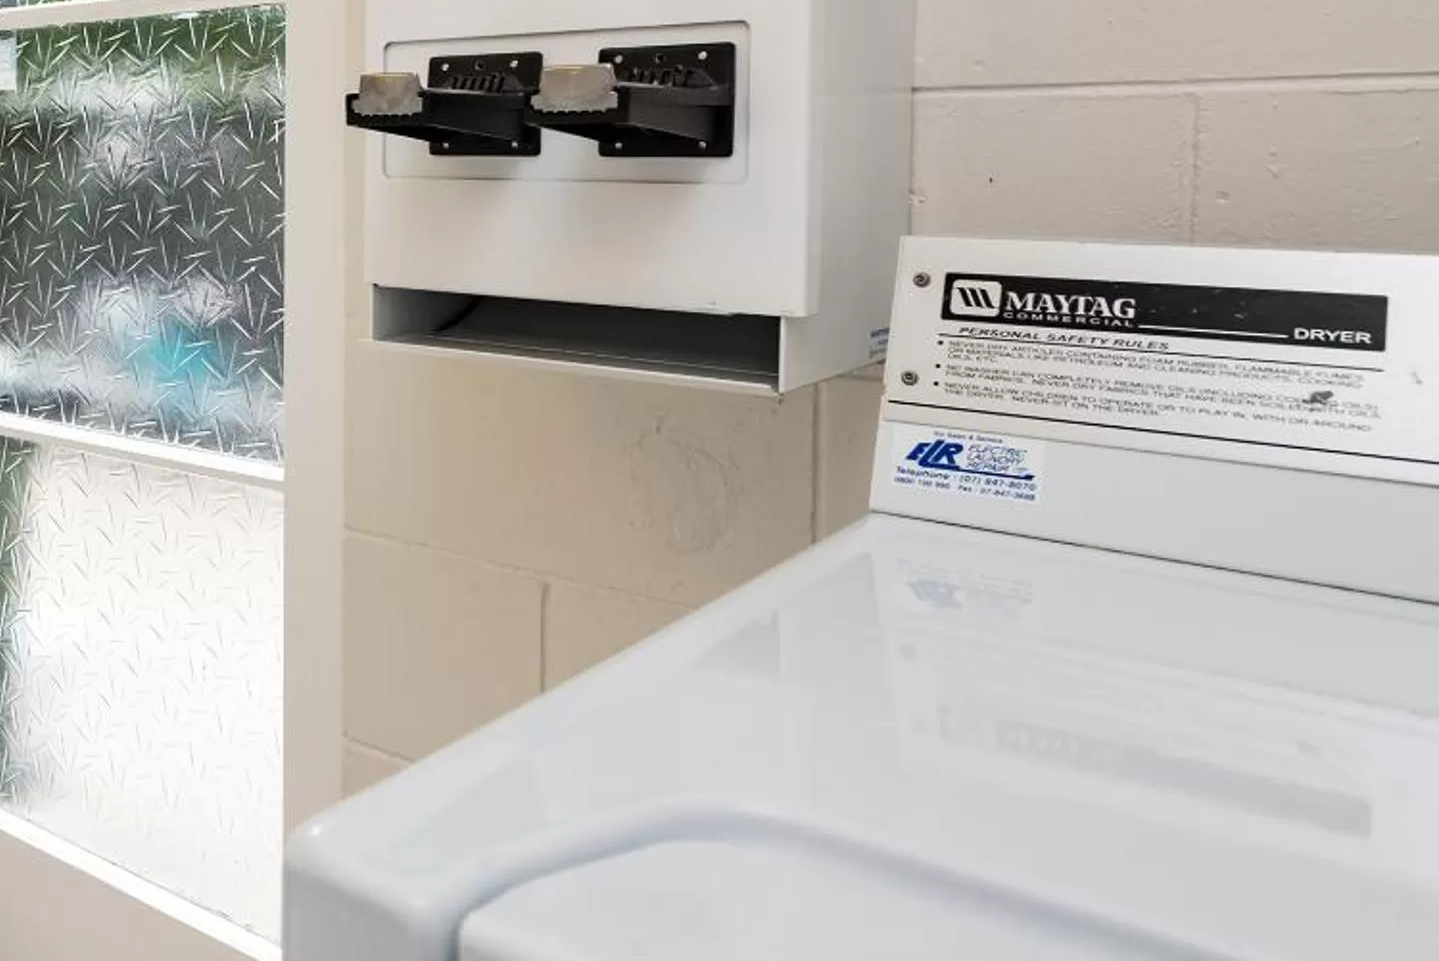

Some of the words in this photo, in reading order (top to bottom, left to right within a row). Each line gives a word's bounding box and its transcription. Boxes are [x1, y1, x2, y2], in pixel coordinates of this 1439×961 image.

[1005, 290, 1137, 320] MAYTAG
[1003, 311, 1135, 328] COMMERCIAL
[958, 326, 1040, 340] PERSONAL
[1047, 333, 1110, 345] SAFETY
[1112, 338, 1169, 350] RULES
[1293, 326, 1373, 345] DRYER
